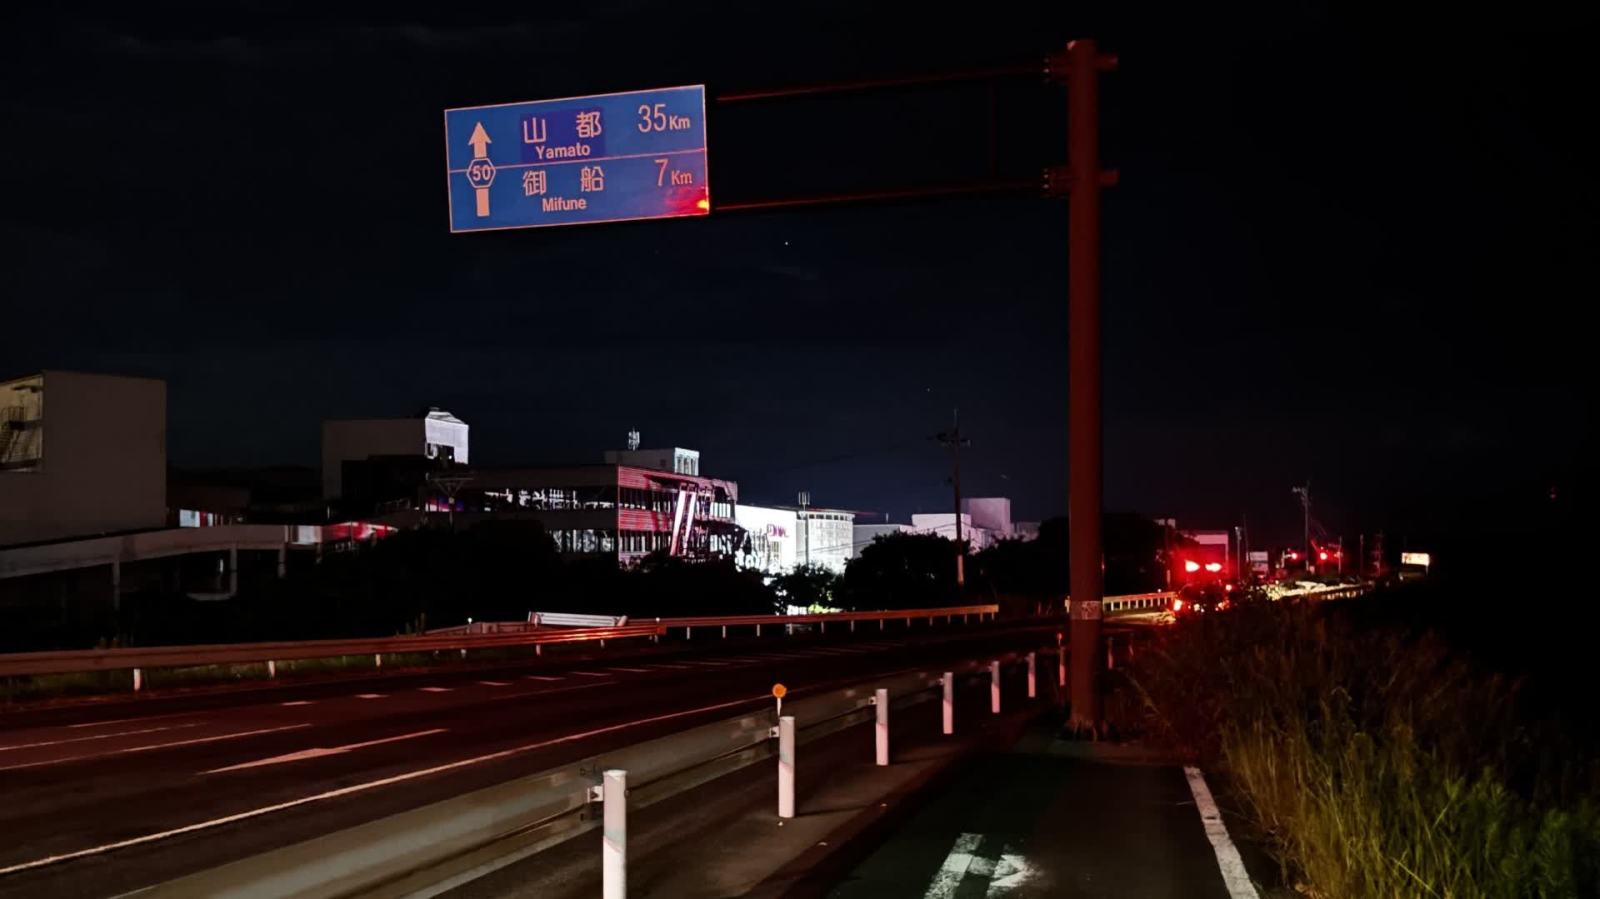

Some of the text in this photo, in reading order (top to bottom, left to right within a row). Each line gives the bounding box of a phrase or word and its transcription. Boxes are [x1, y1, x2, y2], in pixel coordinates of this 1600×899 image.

[523, 111, 602, 143] 山都
[638, 104, 667, 132] 35
[535, 142, 591, 160] Yamato
[472, 165, 491, 181] 50
[523, 166, 604, 196] 御船
[655, 158, 669, 187] 7
[542, 197, 587, 212] Mifune
